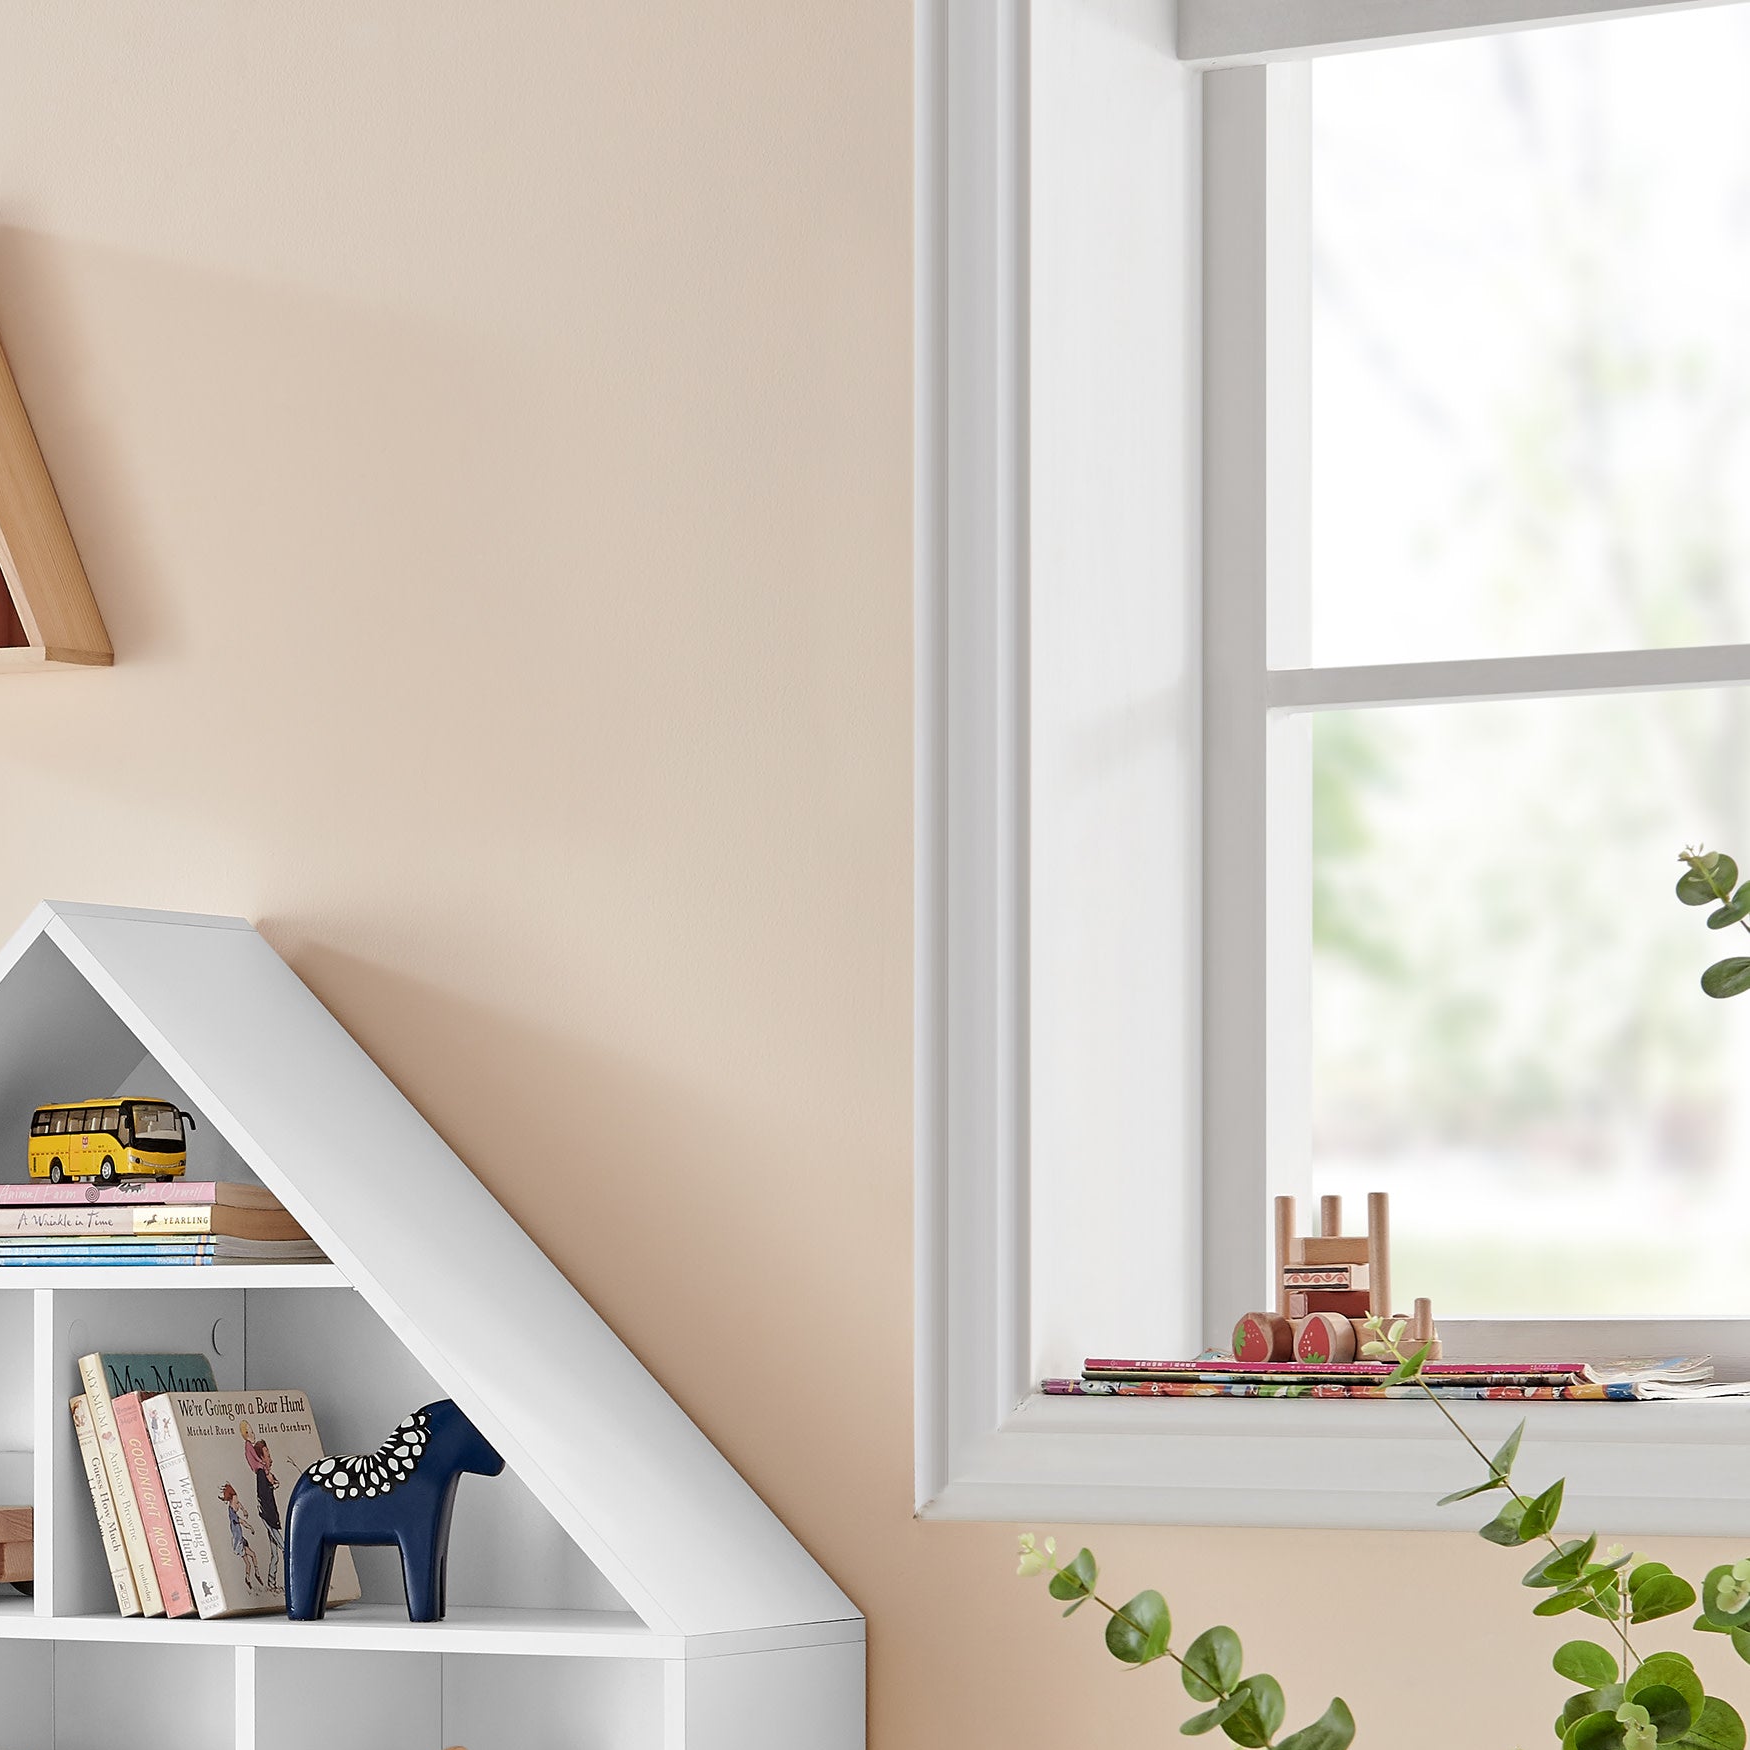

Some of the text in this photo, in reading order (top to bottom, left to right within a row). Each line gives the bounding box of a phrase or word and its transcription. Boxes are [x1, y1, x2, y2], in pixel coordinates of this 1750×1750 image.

[42, 1185, 76, 1203] Farm
[160, 1183, 207, 1201] Orwell
[17, 1210, 113, 1230] A Wrinkle in Time
[163, 1217, 209, 1225] YEARLING
[150, 1365, 210, 1392] Mum
[86, 1369, 109, 1428] MY MUM
[205, 1398, 235, 1421] Going
[235, 1403, 246, 1415] on
[249, 1402, 254, 1414] a
[255, 1397, 278, 1414] Bear
[279, 1395, 305, 1413] Hunt
[187, 1425, 235, 1437] Michael Rosen
[258, 1422, 312, 1434] Helen Oxenbury
[91, 1457, 103, 1490] Guess
[100, 1492, 111, 1523] How
[107, 1520, 121, 1552] Much
[109, 1451, 137, 1542] Anthony Browne
[129, 1438, 173, 1567] GOODNIGHT MOON
[170, 1500, 185, 1528] Bear
[180, 1532, 196, 1562] Hunt
[189, 1511, 204, 1548] Going
[199, 1551, 210, 1564] on
